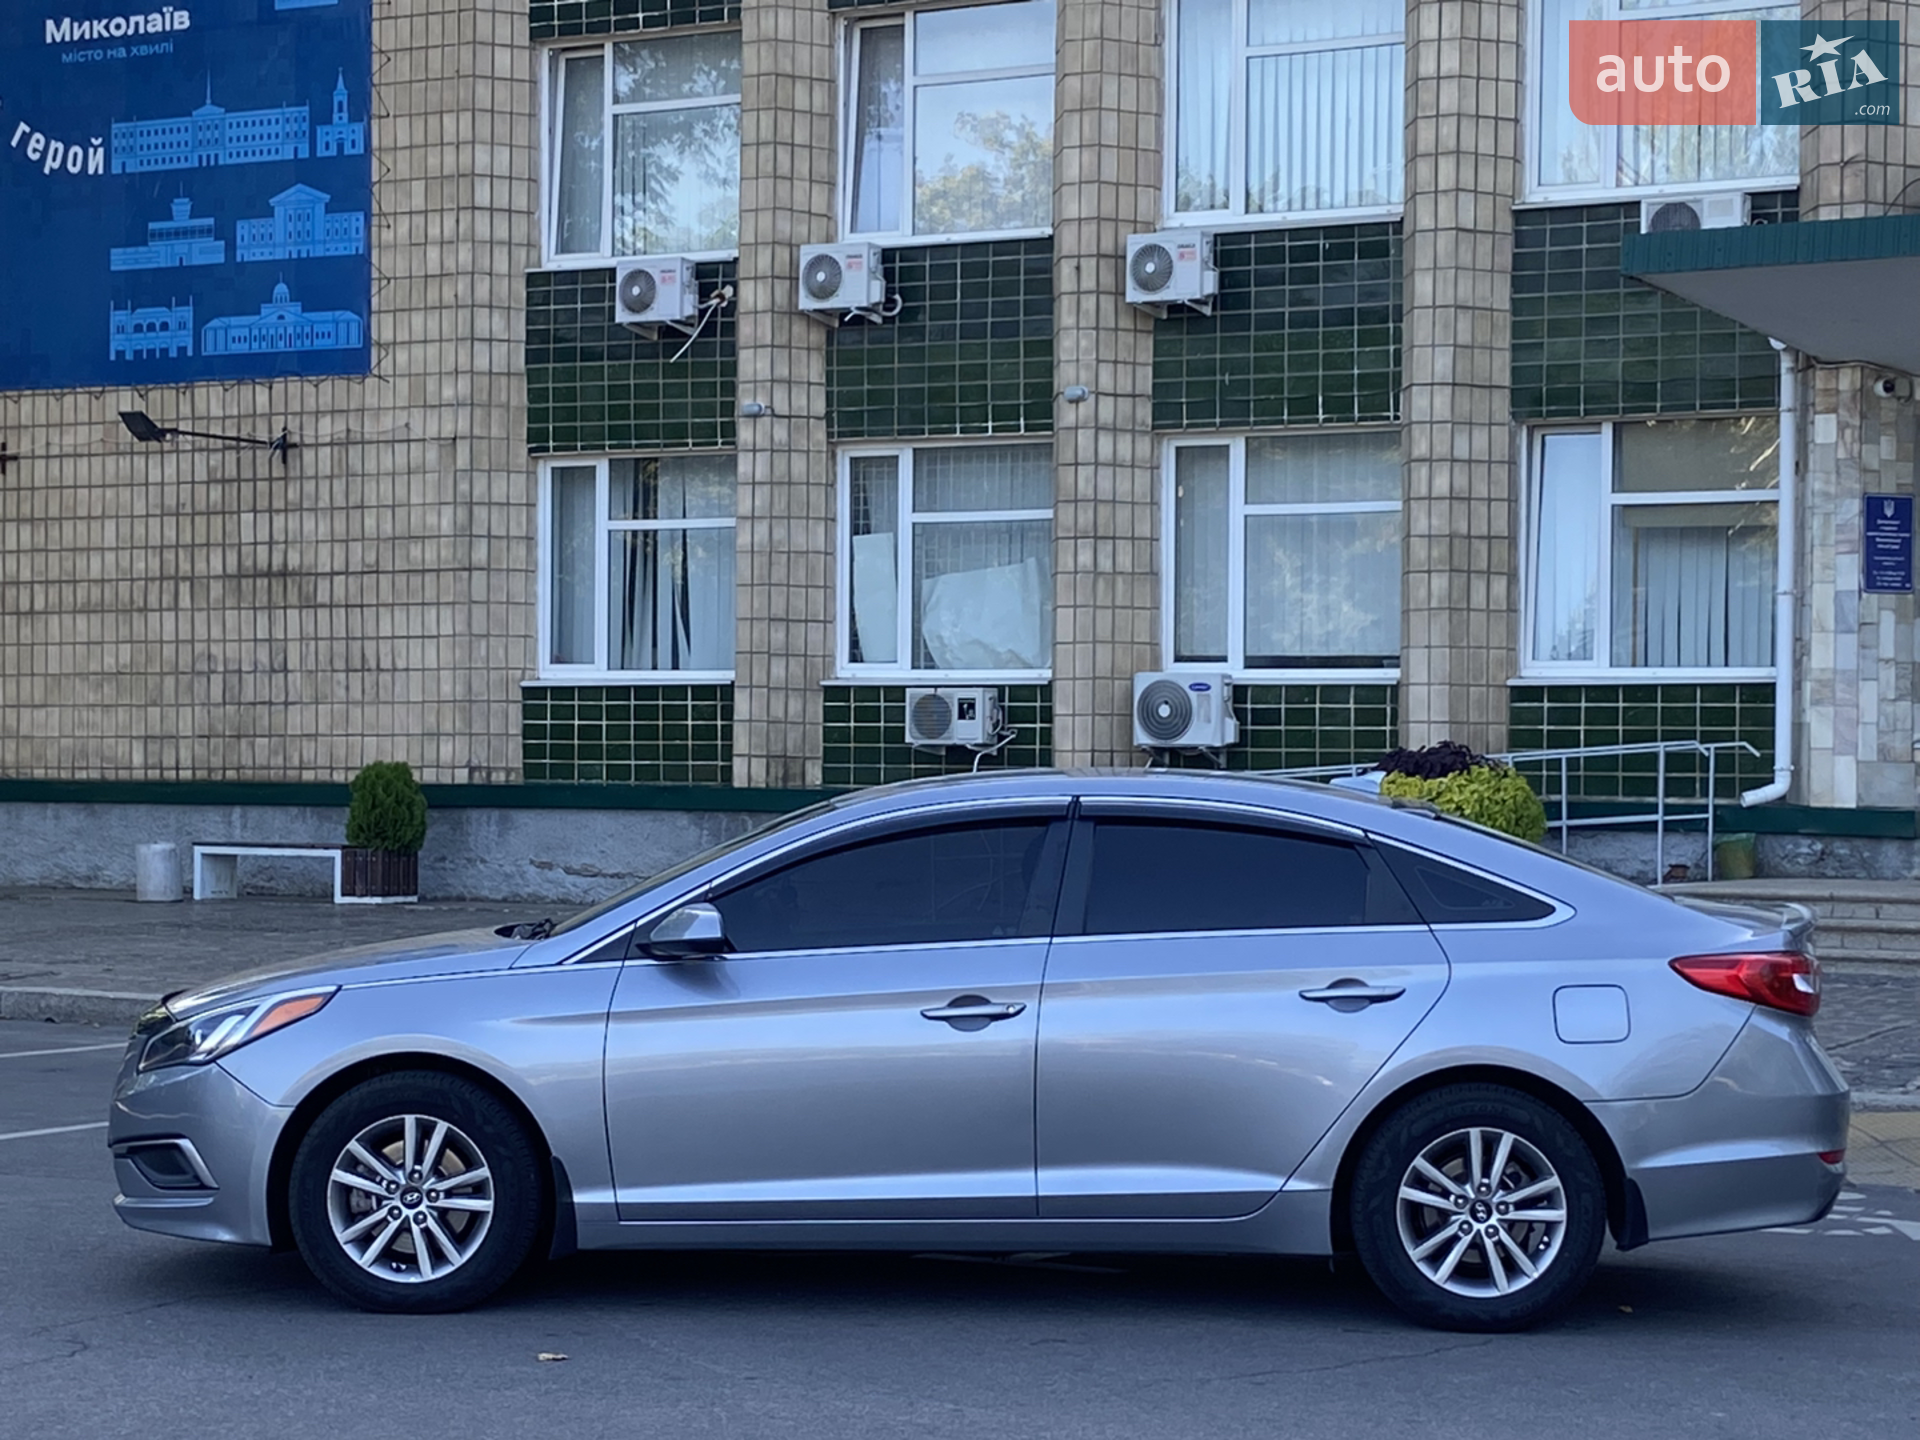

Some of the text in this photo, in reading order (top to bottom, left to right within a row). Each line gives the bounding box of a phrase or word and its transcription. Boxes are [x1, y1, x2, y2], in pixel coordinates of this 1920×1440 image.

[45, 6, 191, 44] Миколаїв
[61, 38, 174, 64] місто на хвилі
[10, 121, 105, 176] герой
